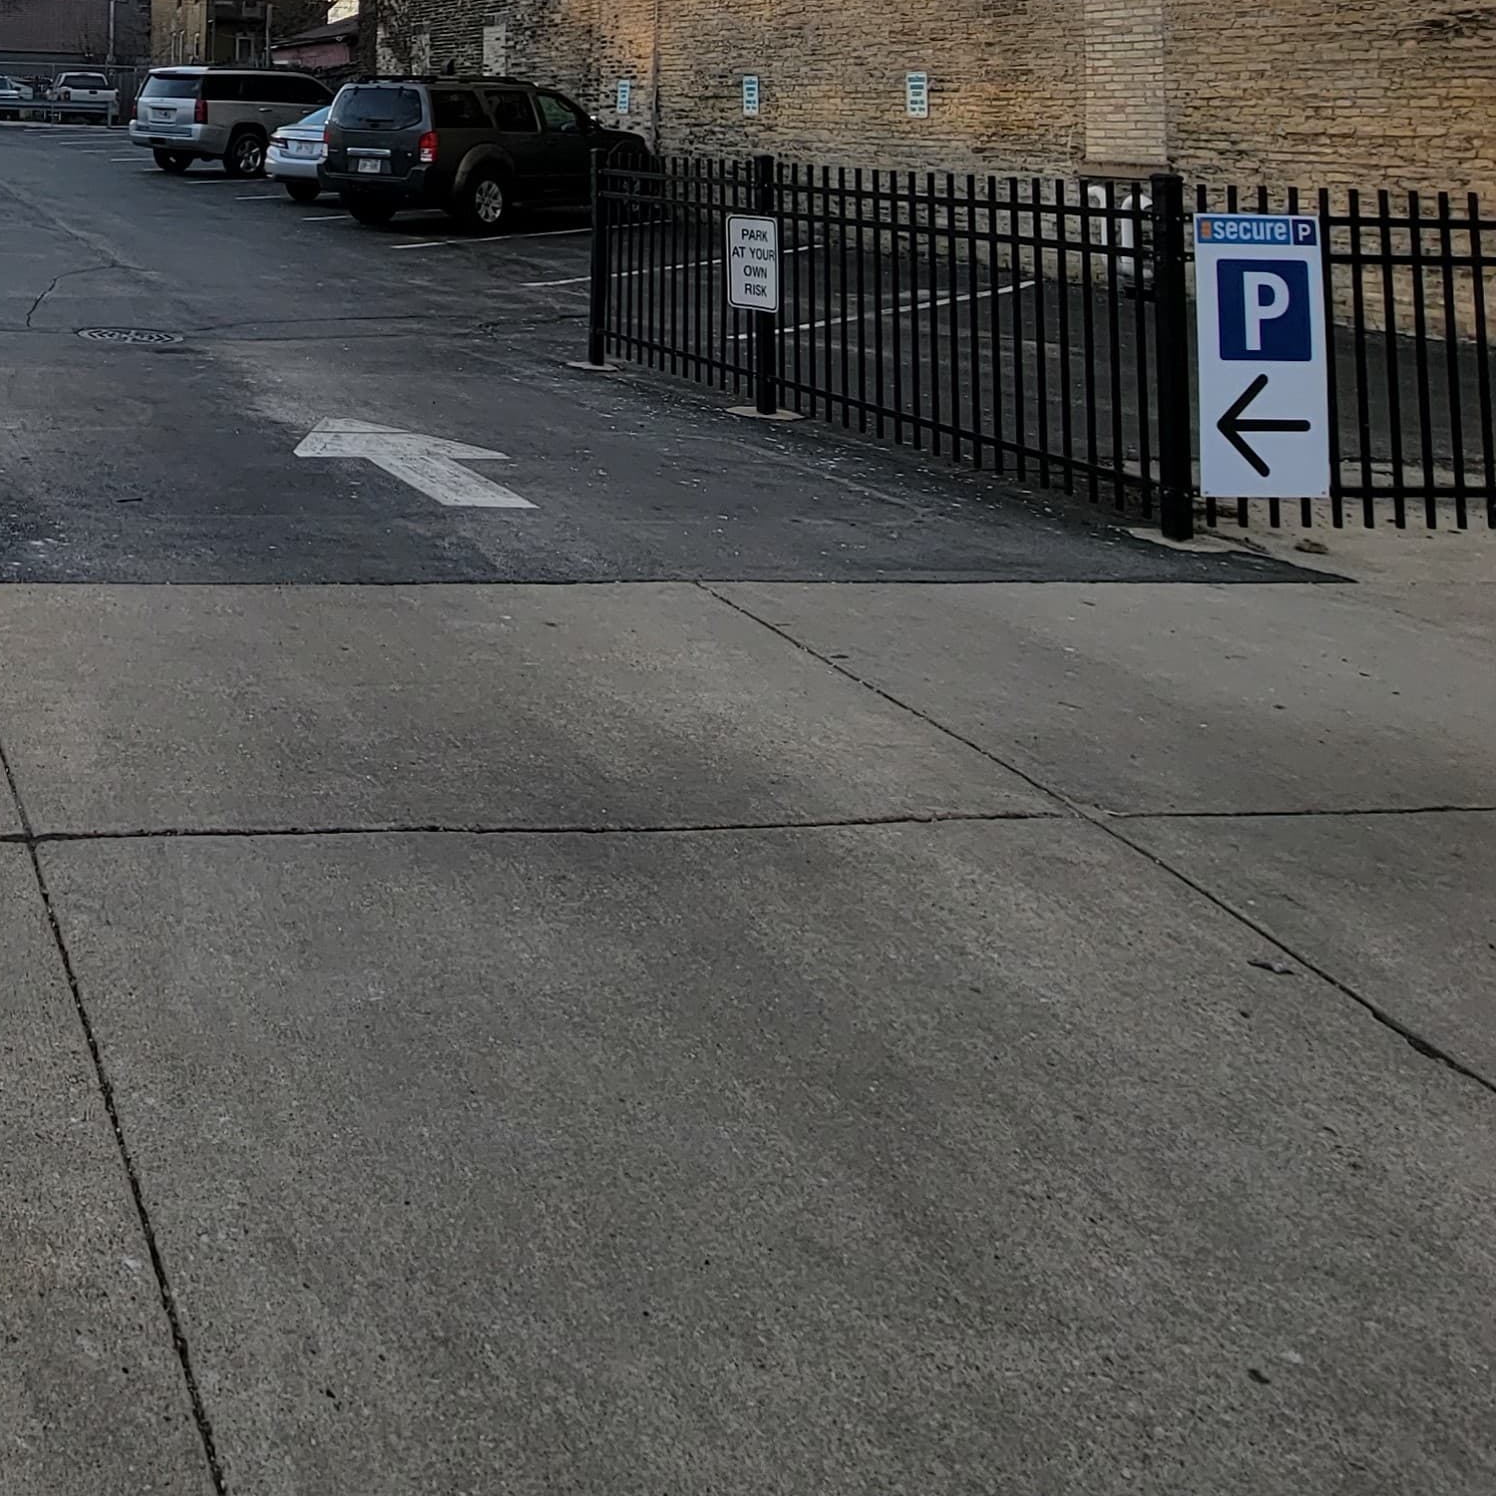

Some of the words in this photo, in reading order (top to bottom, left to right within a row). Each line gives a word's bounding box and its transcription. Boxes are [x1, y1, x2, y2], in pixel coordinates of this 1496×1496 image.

[741, 228, 768, 242] PARK
[1213, 221, 1288, 241] secure
[1298, 223, 1311, 241] P
[732, 246, 746, 258] AT
[749, 247, 775, 261] YOUR
[743, 264, 767, 279] OWN
[744, 283, 767, 297] RISK
[1243, 271, 1290, 351] P
